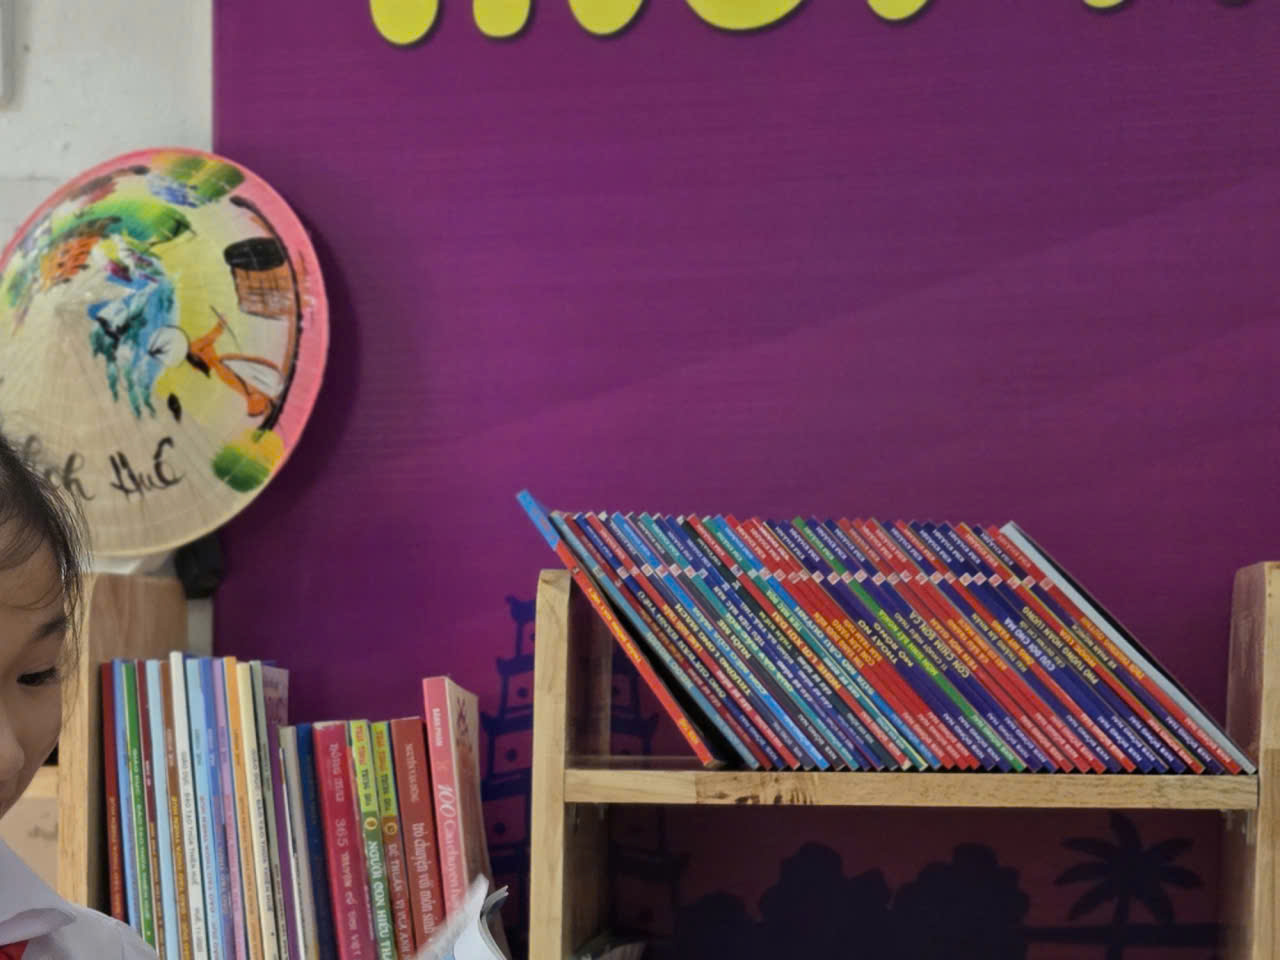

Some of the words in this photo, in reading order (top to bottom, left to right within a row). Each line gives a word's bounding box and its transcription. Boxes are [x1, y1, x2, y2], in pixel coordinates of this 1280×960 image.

[437, 783, 456, 818] 100
[335, 818, 348, 846] 365
[367, 840, 382, 878] NGƯỜI
[372, 881, 385, 905] CON
[376, 909, 389, 937] HIẾU
